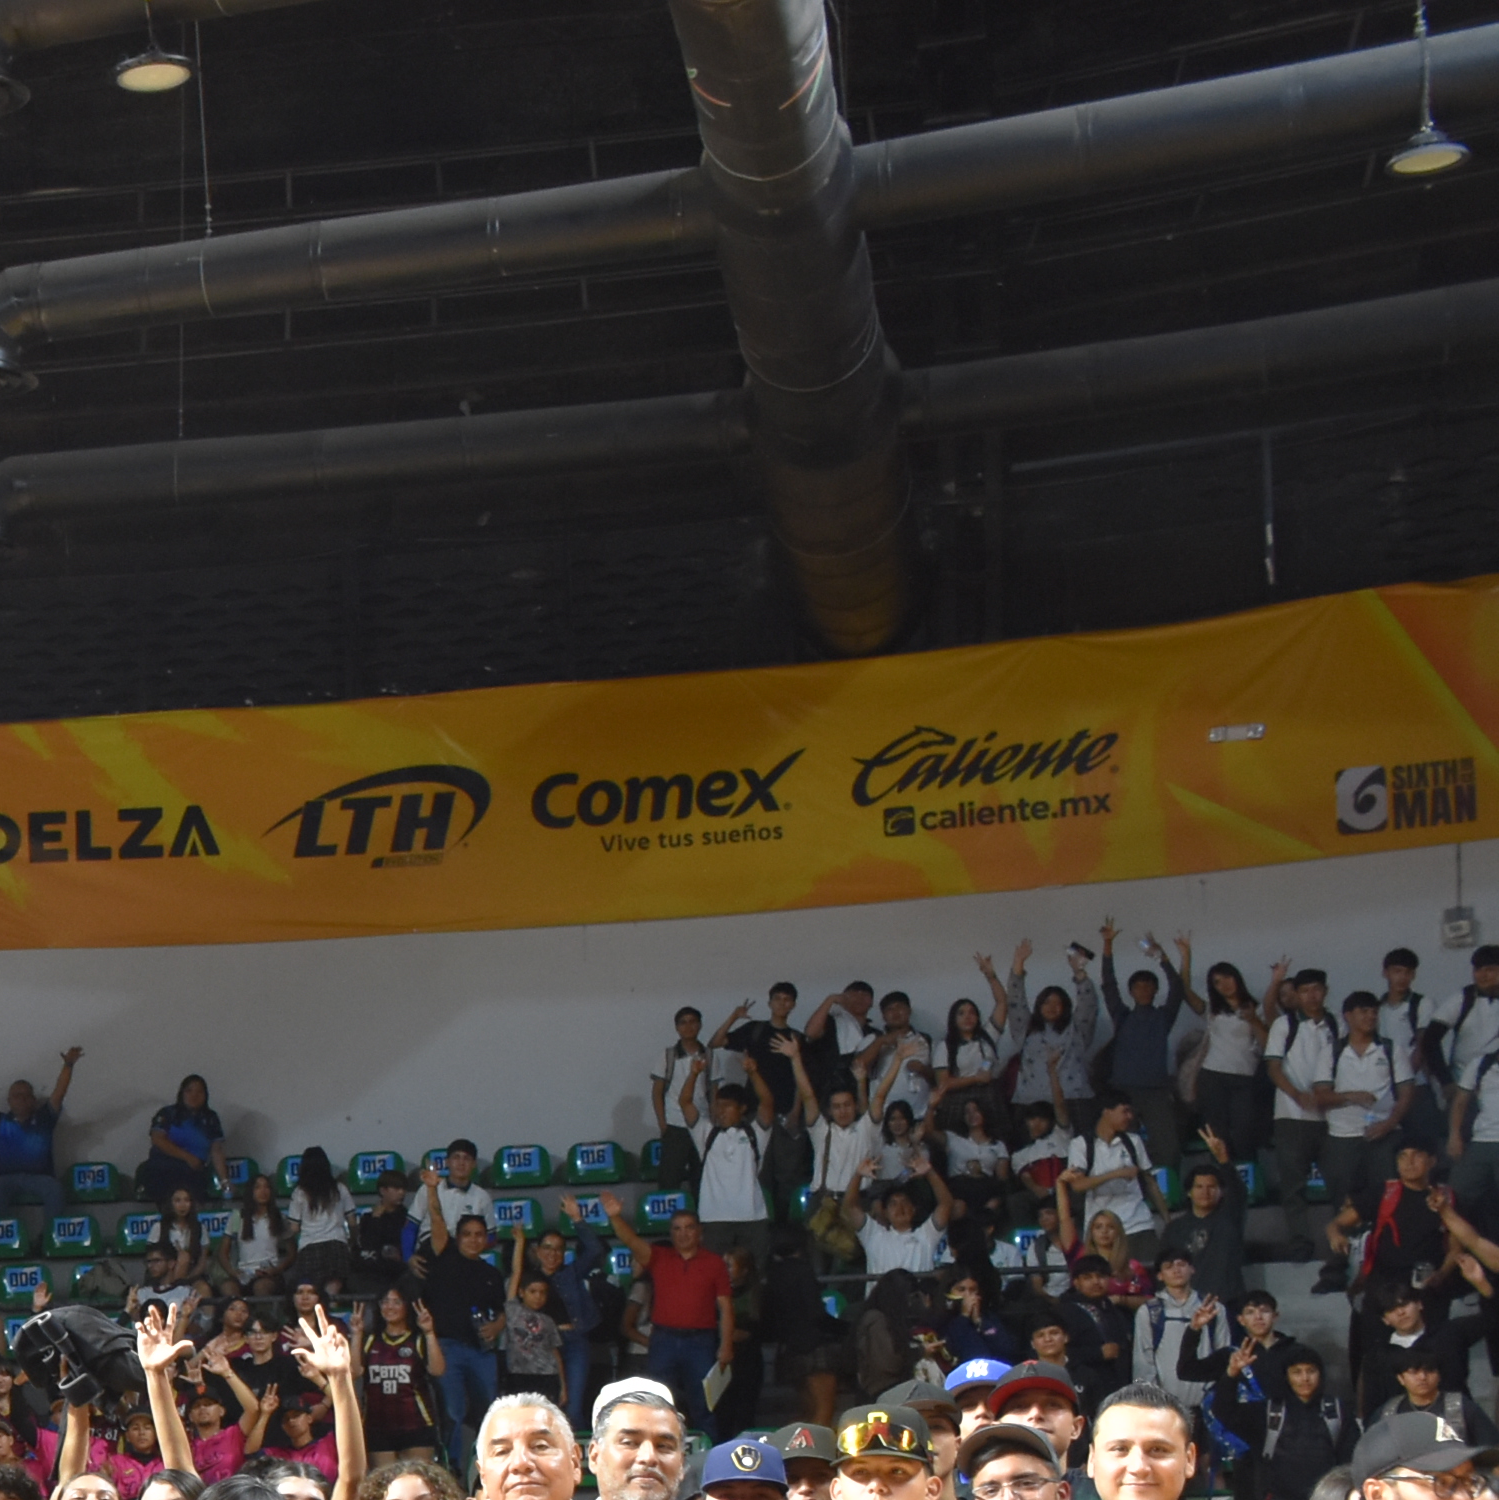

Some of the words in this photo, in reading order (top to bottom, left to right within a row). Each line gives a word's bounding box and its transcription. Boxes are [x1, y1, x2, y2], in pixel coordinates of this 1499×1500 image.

[852, 725, 1118, 806] Caliente
[532, 748, 806, 829] Comex
[920, 793, 1110, 830] caliente.mx
[1394, 784, 1476, 830] MAN
[294, 791, 456, 858] LTH
[600, 834, 650, 852] Vive
[659, 832, 693, 848] tus
[702, 824, 783, 846] sueños
[363, 1159, 386, 1174] 013
[507, 1152, 531, 1168] 015
[58, 1222, 84, 1237] 007
[10, 1272, 37, 1287] 006
[382, 1380, 397, 1395] 81
